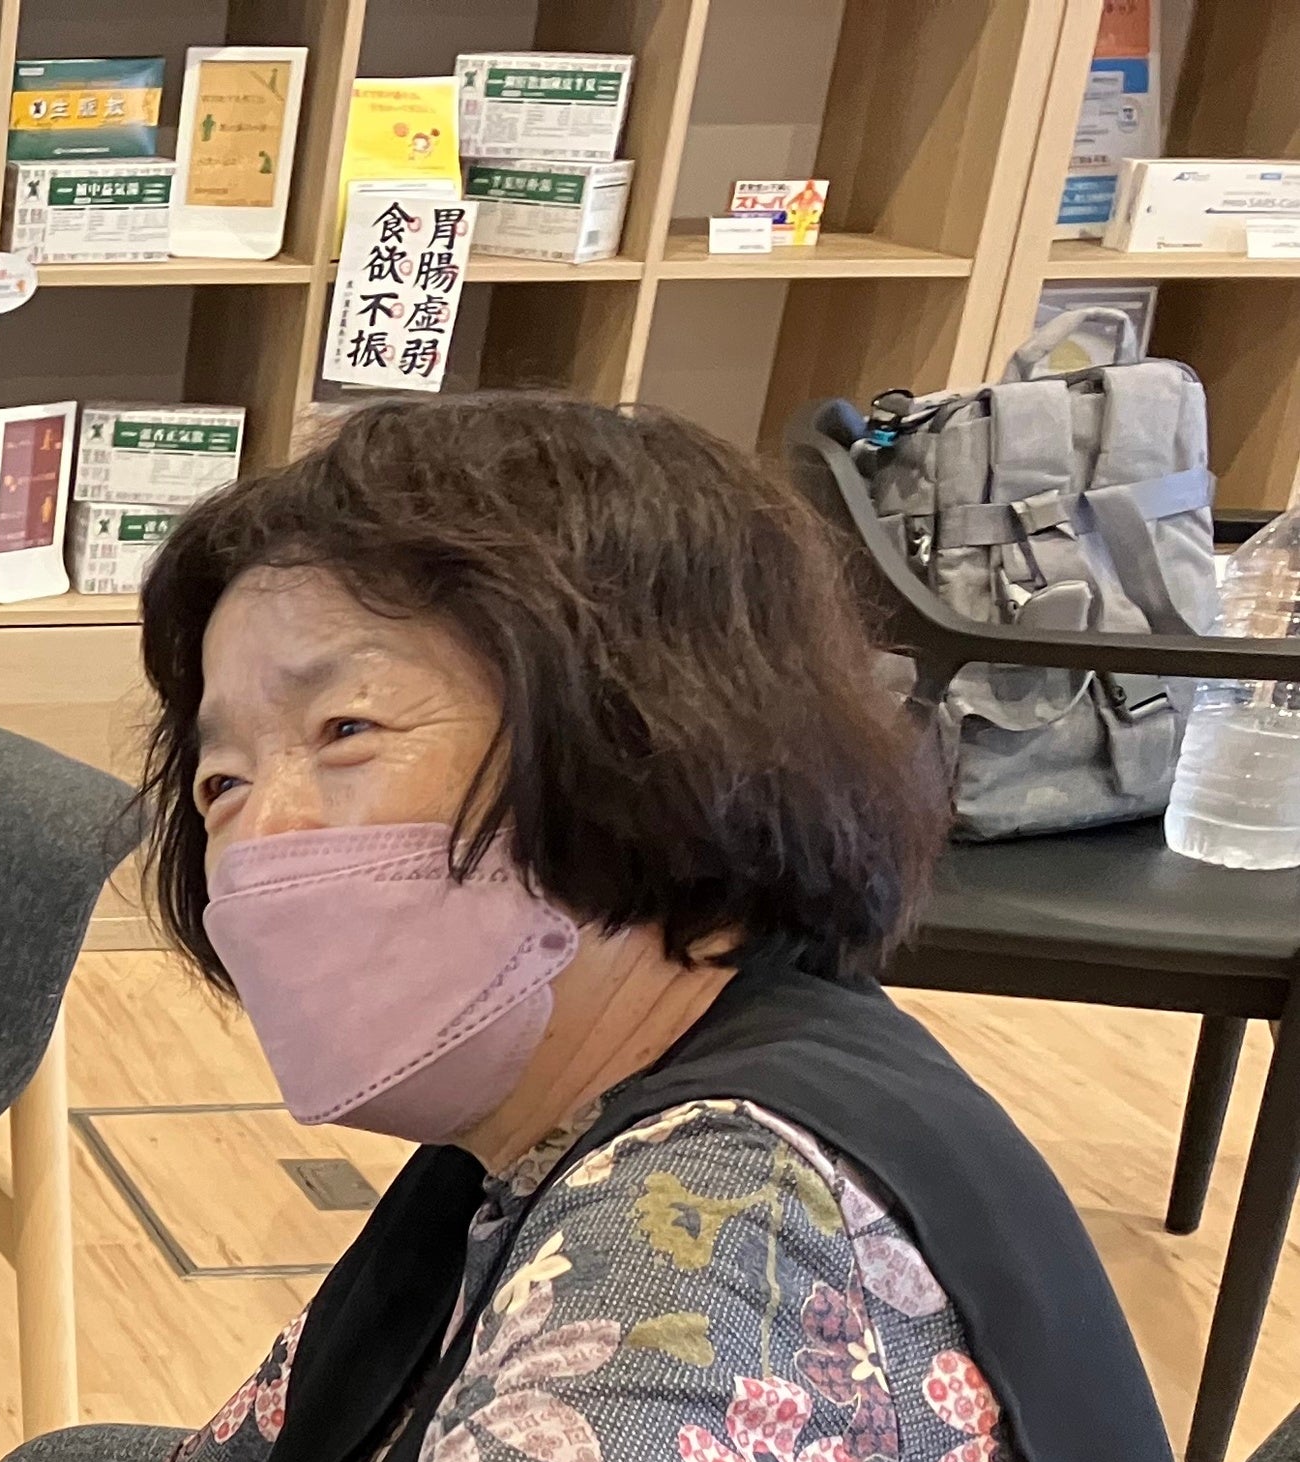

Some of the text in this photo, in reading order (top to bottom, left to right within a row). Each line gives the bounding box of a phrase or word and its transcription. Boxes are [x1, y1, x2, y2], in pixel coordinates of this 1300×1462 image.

[346, 201, 416, 369] 食欲不振
[398, 207, 466, 378] 胃腸虚弱
